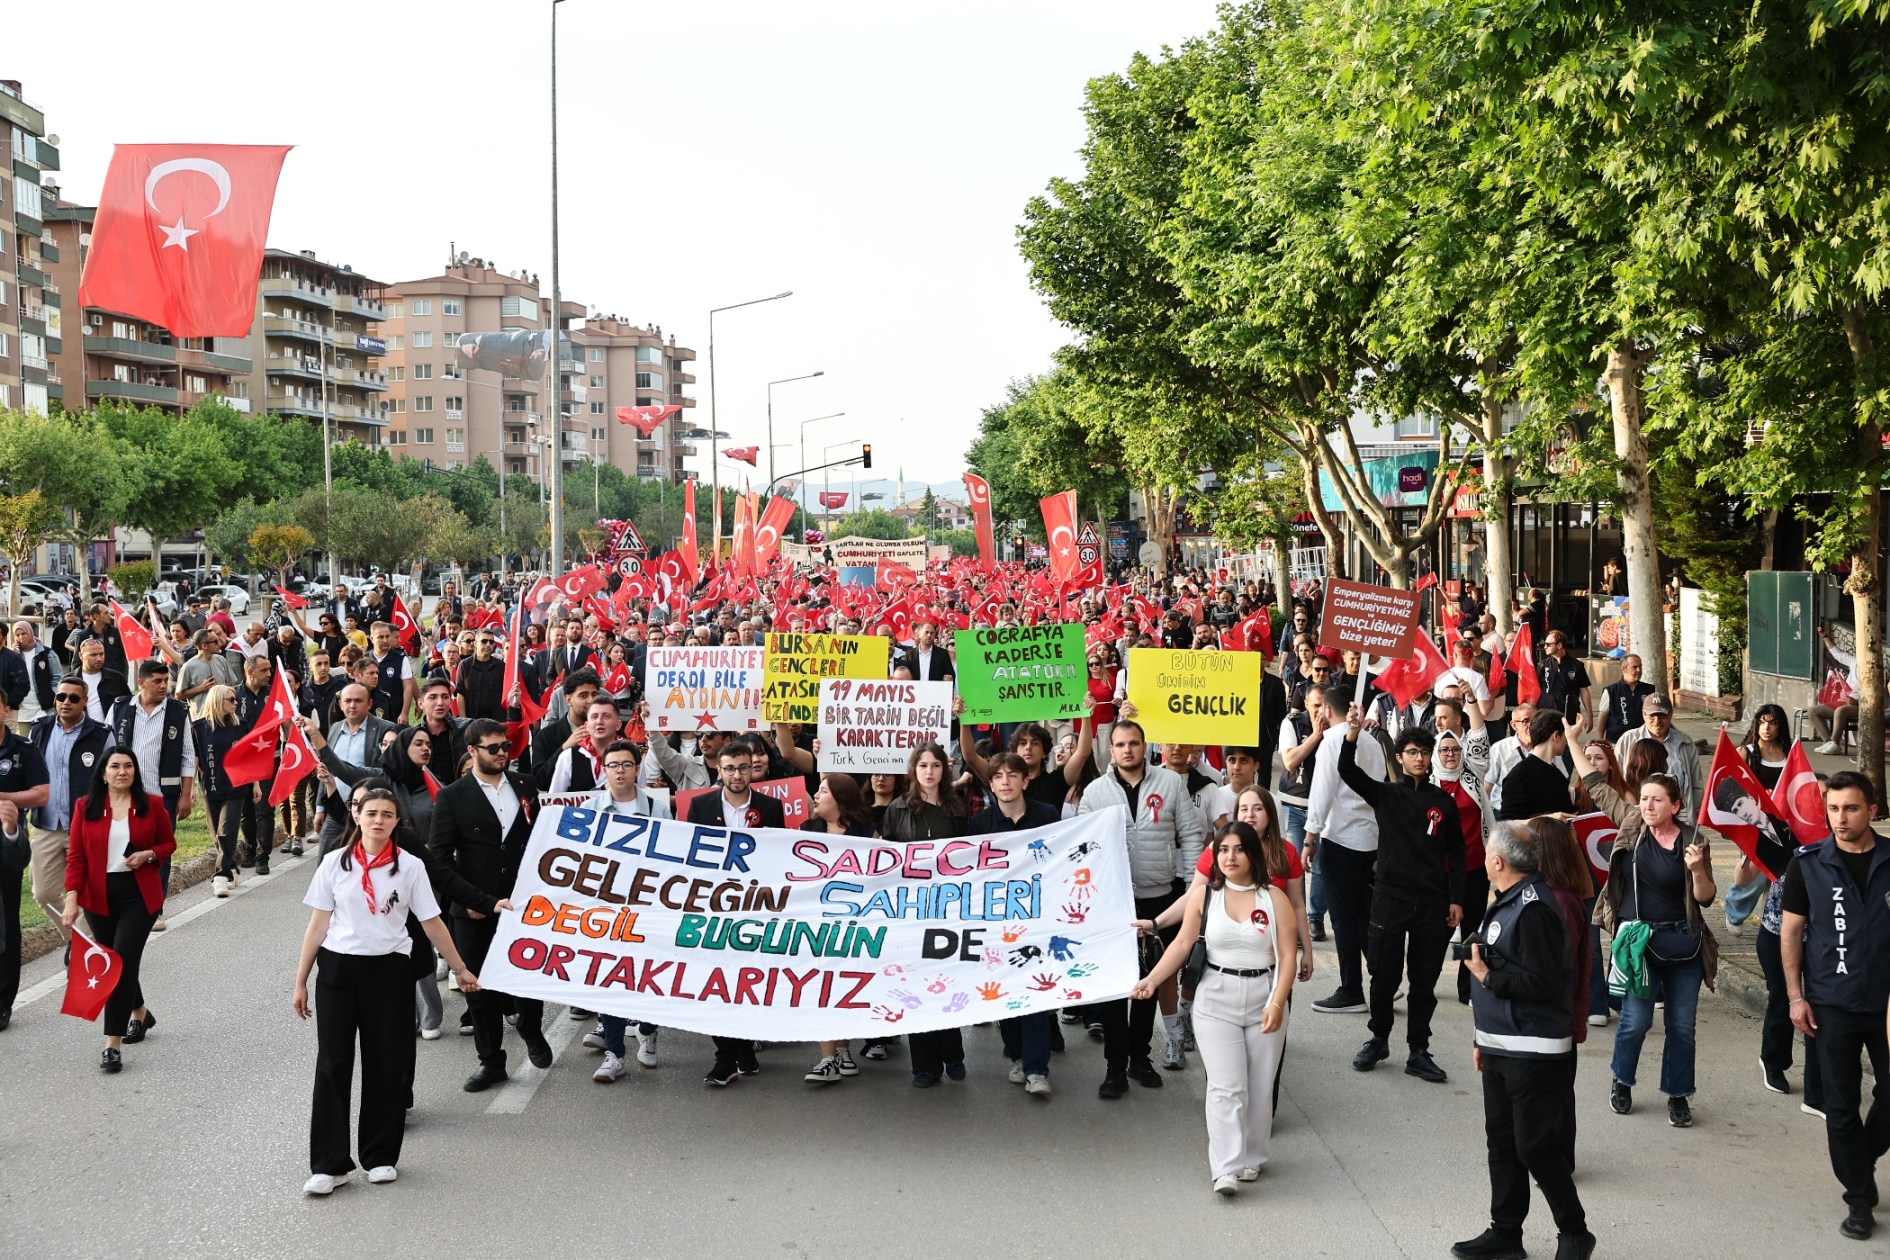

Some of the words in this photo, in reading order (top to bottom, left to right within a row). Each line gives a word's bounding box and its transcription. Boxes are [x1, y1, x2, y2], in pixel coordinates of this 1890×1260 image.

[1402, 473, 1422, 482] hadi
[837, 550, 896, 558] CUMHURİYETİ
[845, 560, 877, 568] VATANI
[1082, 551, 1094, 560] 30
[622, 561, 638, 573] 30
[1333, 586, 1392, 604] Emperyalizme
[1393, 596, 1414, 609] karşı
[1333, 598, 1412, 618] CUMHURİYETİMİZ
[975, 625, 1064, 646] COĞRAFYA
[1333, 615, 1407, 636] GENÇLİĞİMİZ
[769, 633, 859, 655] BURSA'NIN
[1339, 629, 1362, 643] bize
[1363, 637, 1398, 648] yeter!
[984, 642, 1063, 665] KADERSE
[1171, 650, 1234, 673] BÜTÜN
[768, 657, 846, 678] GENÇLERİ
[657, 668, 706, 689] DERDİ
[714, 668, 747, 689] BİLE
[1156, 672, 1206, 689] ÜMİDİM
[829, 679, 852, 701] 19
[855, 682, 916, 704] MAYIS
[1167, 691, 1247, 717] GENÇLİK
[825, 703, 852, 725] BİR
[854, 703, 902, 727] TARİH
[908, 704, 949, 729] DEĞİL
[207, 744, 217, 792] ZABITA
[830, 750, 855, 765] Türk
[785, 840, 1009, 881] SADECE
[538, 847, 791, 913] GELECEĞİN
[820, 873, 1042, 921] SAHİPLERİ
[674, 912, 887, 959] BUGÜNÜN
[921, 927, 987, 962] DE
[1831, 886, 1849, 975] ZABITA
[508, 937, 875, 1009] ORTAKLARIYIZ
